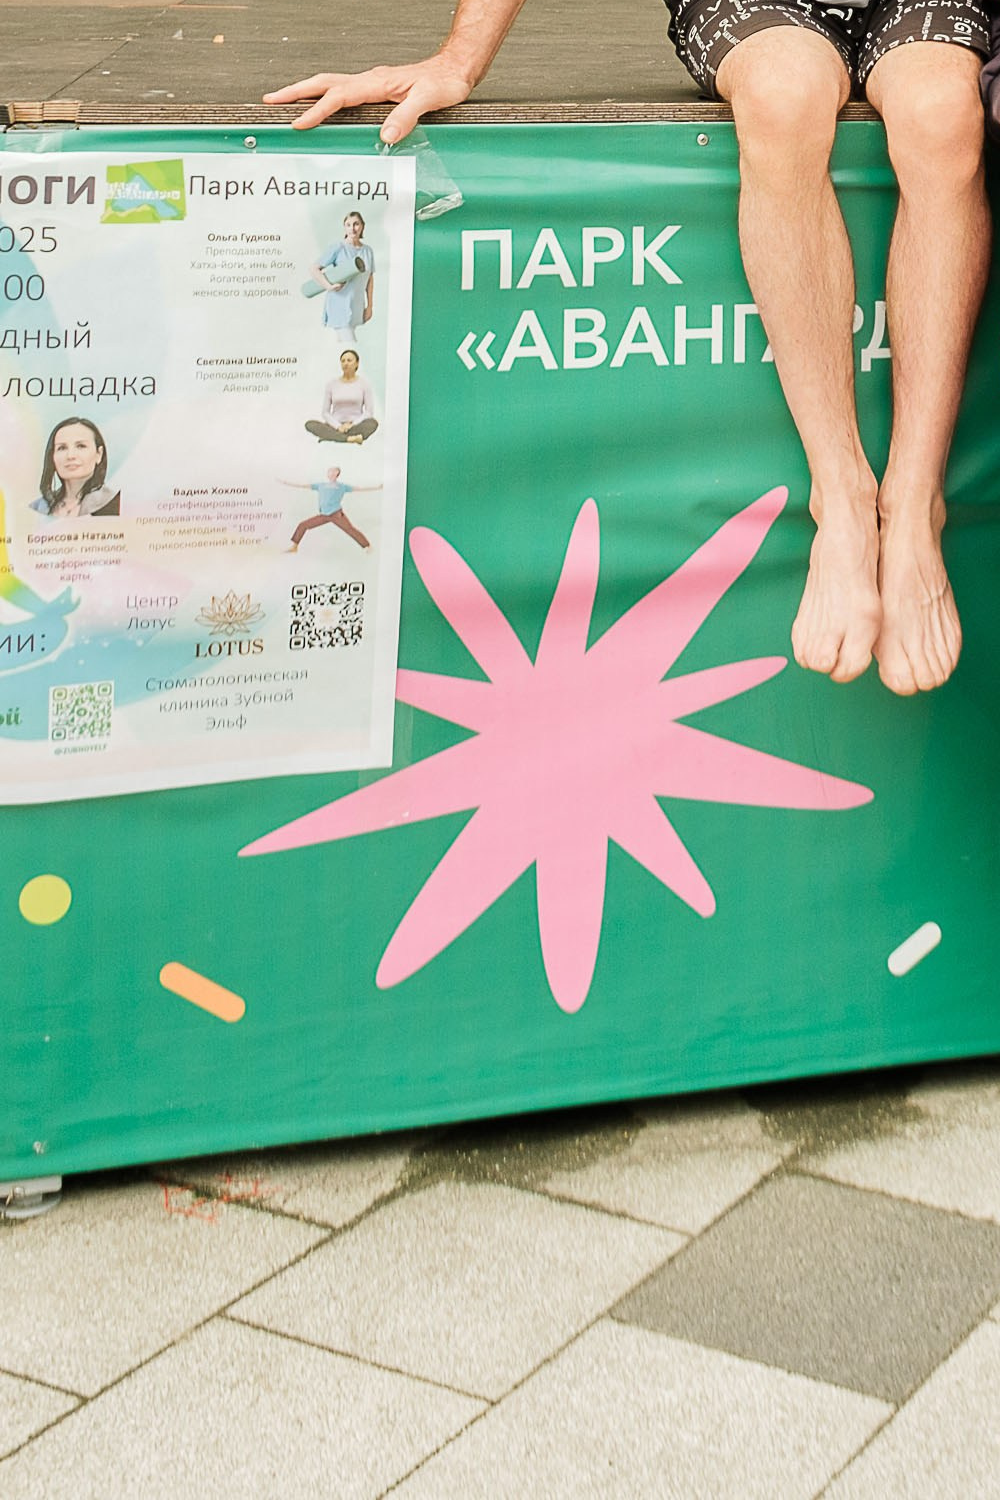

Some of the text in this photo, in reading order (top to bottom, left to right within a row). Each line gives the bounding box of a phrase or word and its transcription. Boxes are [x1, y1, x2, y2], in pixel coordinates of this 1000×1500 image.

[0, 175, 96, 205] оги
[189, 175, 255, 200] Парк
[263, 175, 390, 201] Авангард
[207, 232, 281, 243] Ольга Гудкова
[205, 246, 282, 258] Преподаватель
[460, 224, 684, 291] ПАРК
[0, 320, 92, 356] дный
[196, 355, 298, 367] Светлана Шиганова
[195, 370, 272, 382] Преподаватель
[2, 376, 157, 403] лощадка
[172, 486, 249, 498] Вадим Хоклов
[156, 498, 264, 512] сертифицированный
[27, 531, 125, 545] Борисова Наталья
[126, 595, 179, 611] Центр
[127, 616, 176, 631] Лотус
[194, 638, 264, 659] LOTUS
[145, 669, 309, 693] Стоматологическая
[159, 687, 295, 713] клиника Зубной
[205, 713, 248, 732] Эльф
